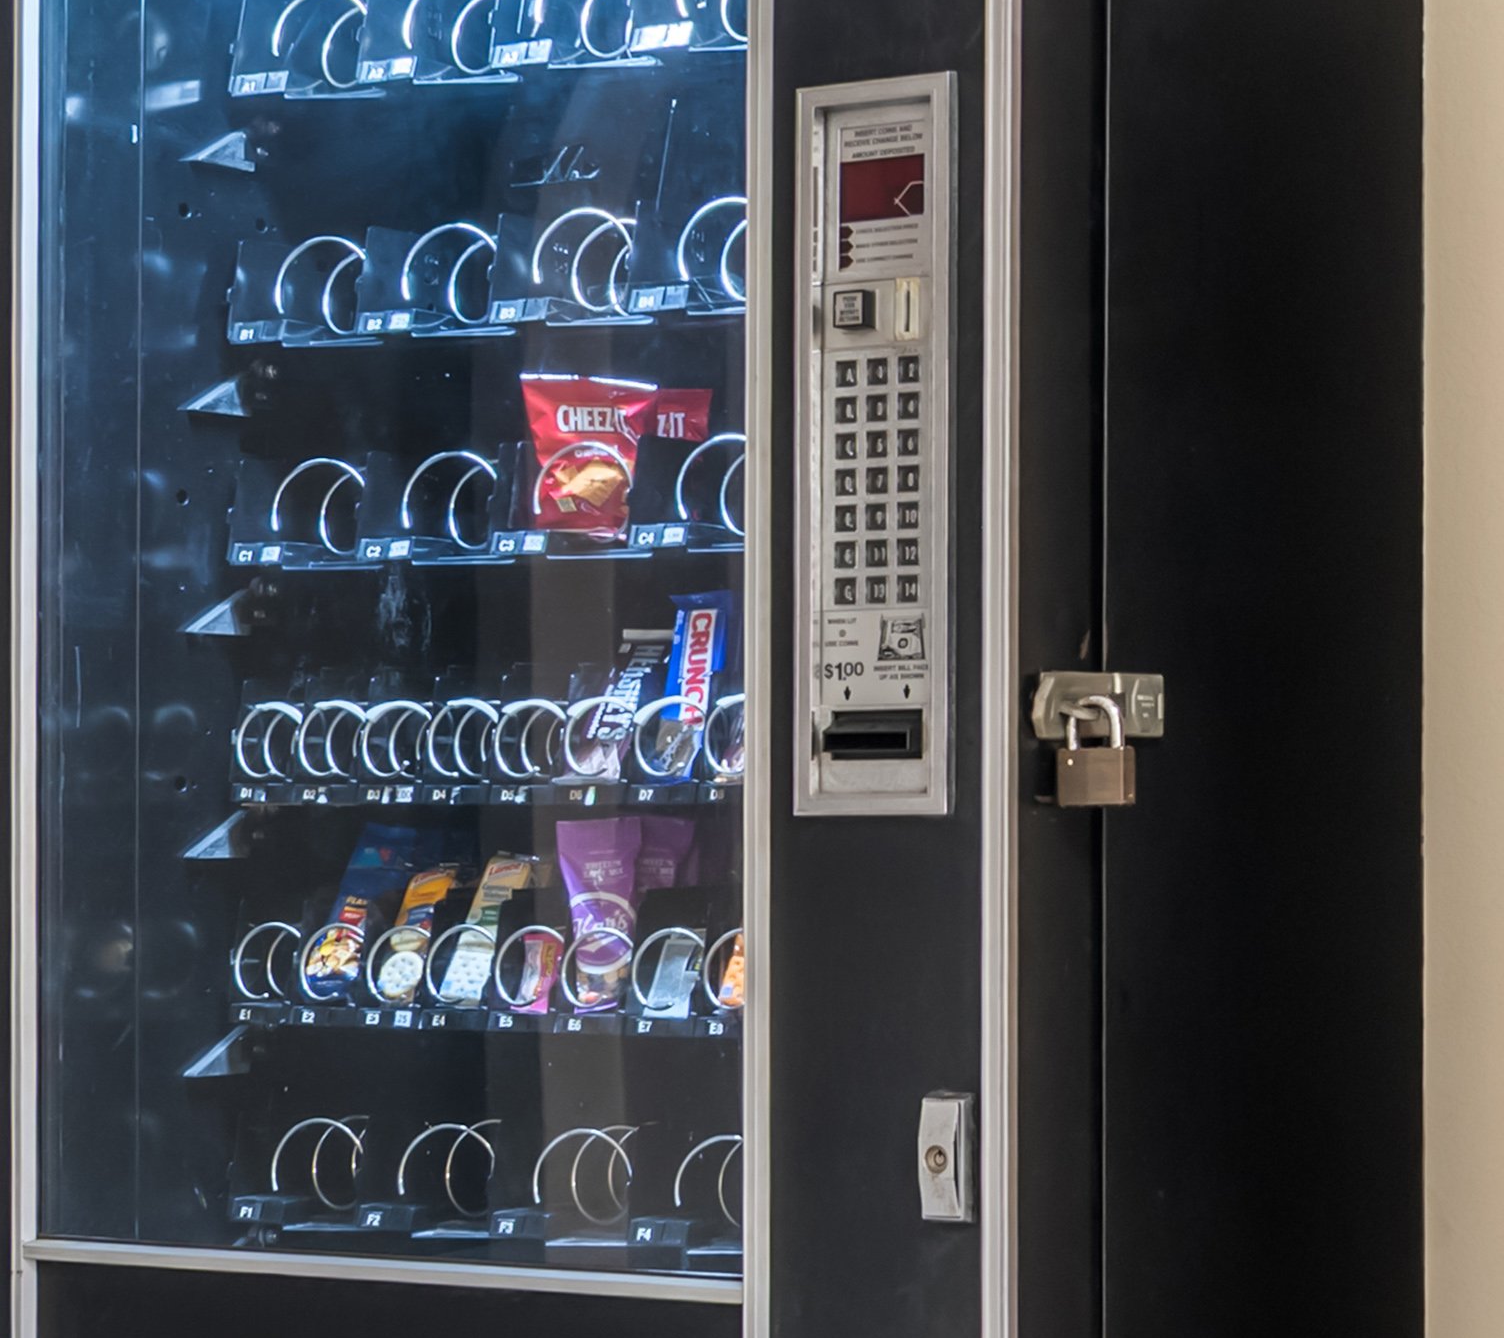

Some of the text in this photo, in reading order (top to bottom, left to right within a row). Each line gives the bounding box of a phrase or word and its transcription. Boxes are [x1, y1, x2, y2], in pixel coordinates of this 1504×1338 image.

[367, 318, 383, 330] B2
[239, 329, 254, 340] B1
[905, 509, 917, 524] 10
[638, 532, 655, 545] C4
[366, 545, 382, 558] C2
[498, 539, 515, 552] C3
[238, 550, 253, 562] C1
[873, 546, 886, 561] 11
[905, 546, 917, 561] 12
[873, 583, 885, 598] 13
[905, 582, 917, 597] 14
[683, 612, 713, 726] CRUNCH
[824, 661, 865, 681] $1.00
[239, 788, 252, 799] D1
[302, 788, 317, 800] D2
[366, 789, 380, 801] D3
[432, 788, 446, 801] D4
[500, 789, 514, 801] D5
[638, 789, 654, 801] D7
[238, 1009, 252, 1021] E1
[301, 1011, 316, 1024] E2
[365, 1013, 380, 1025] E3
[431, 1014, 446, 1026] E4
[498, 1015, 513, 1029] E5
[567, 1019, 582, 1031] E6
[637, 1021, 652, 1034] E7
[709, 1023, 724, 1036] E8
[239, 1206, 253, 1218] F1
[366, 1213, 382, 1226] F2
[498, 1221, 514, 1234] F3
[636, 1227, 652, 1241] F4
